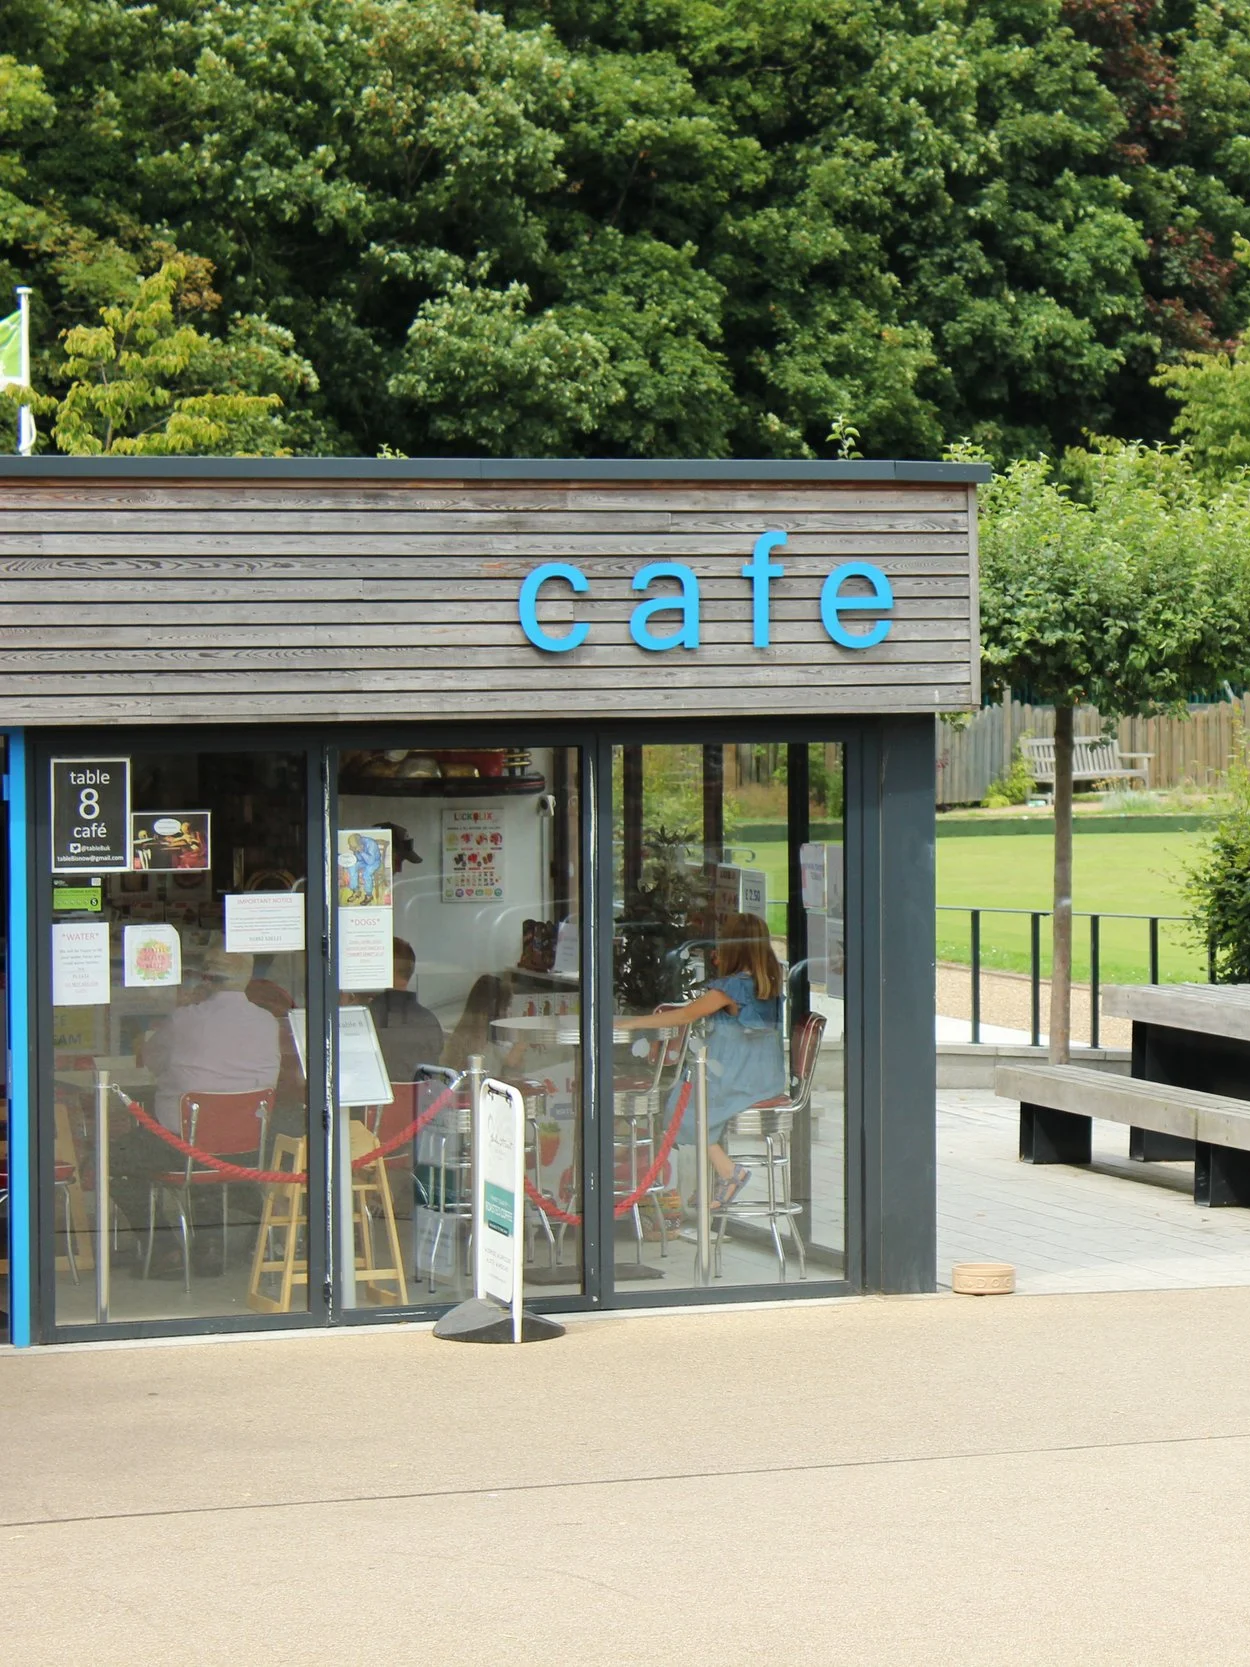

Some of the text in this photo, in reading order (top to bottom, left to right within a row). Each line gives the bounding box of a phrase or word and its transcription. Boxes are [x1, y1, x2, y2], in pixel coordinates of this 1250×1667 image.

[518, 531, 894, 652] cafe
[70, 770, 110, 784] table
[79, 788, 100, 820] 8
[73, 823, 107, 838] café
